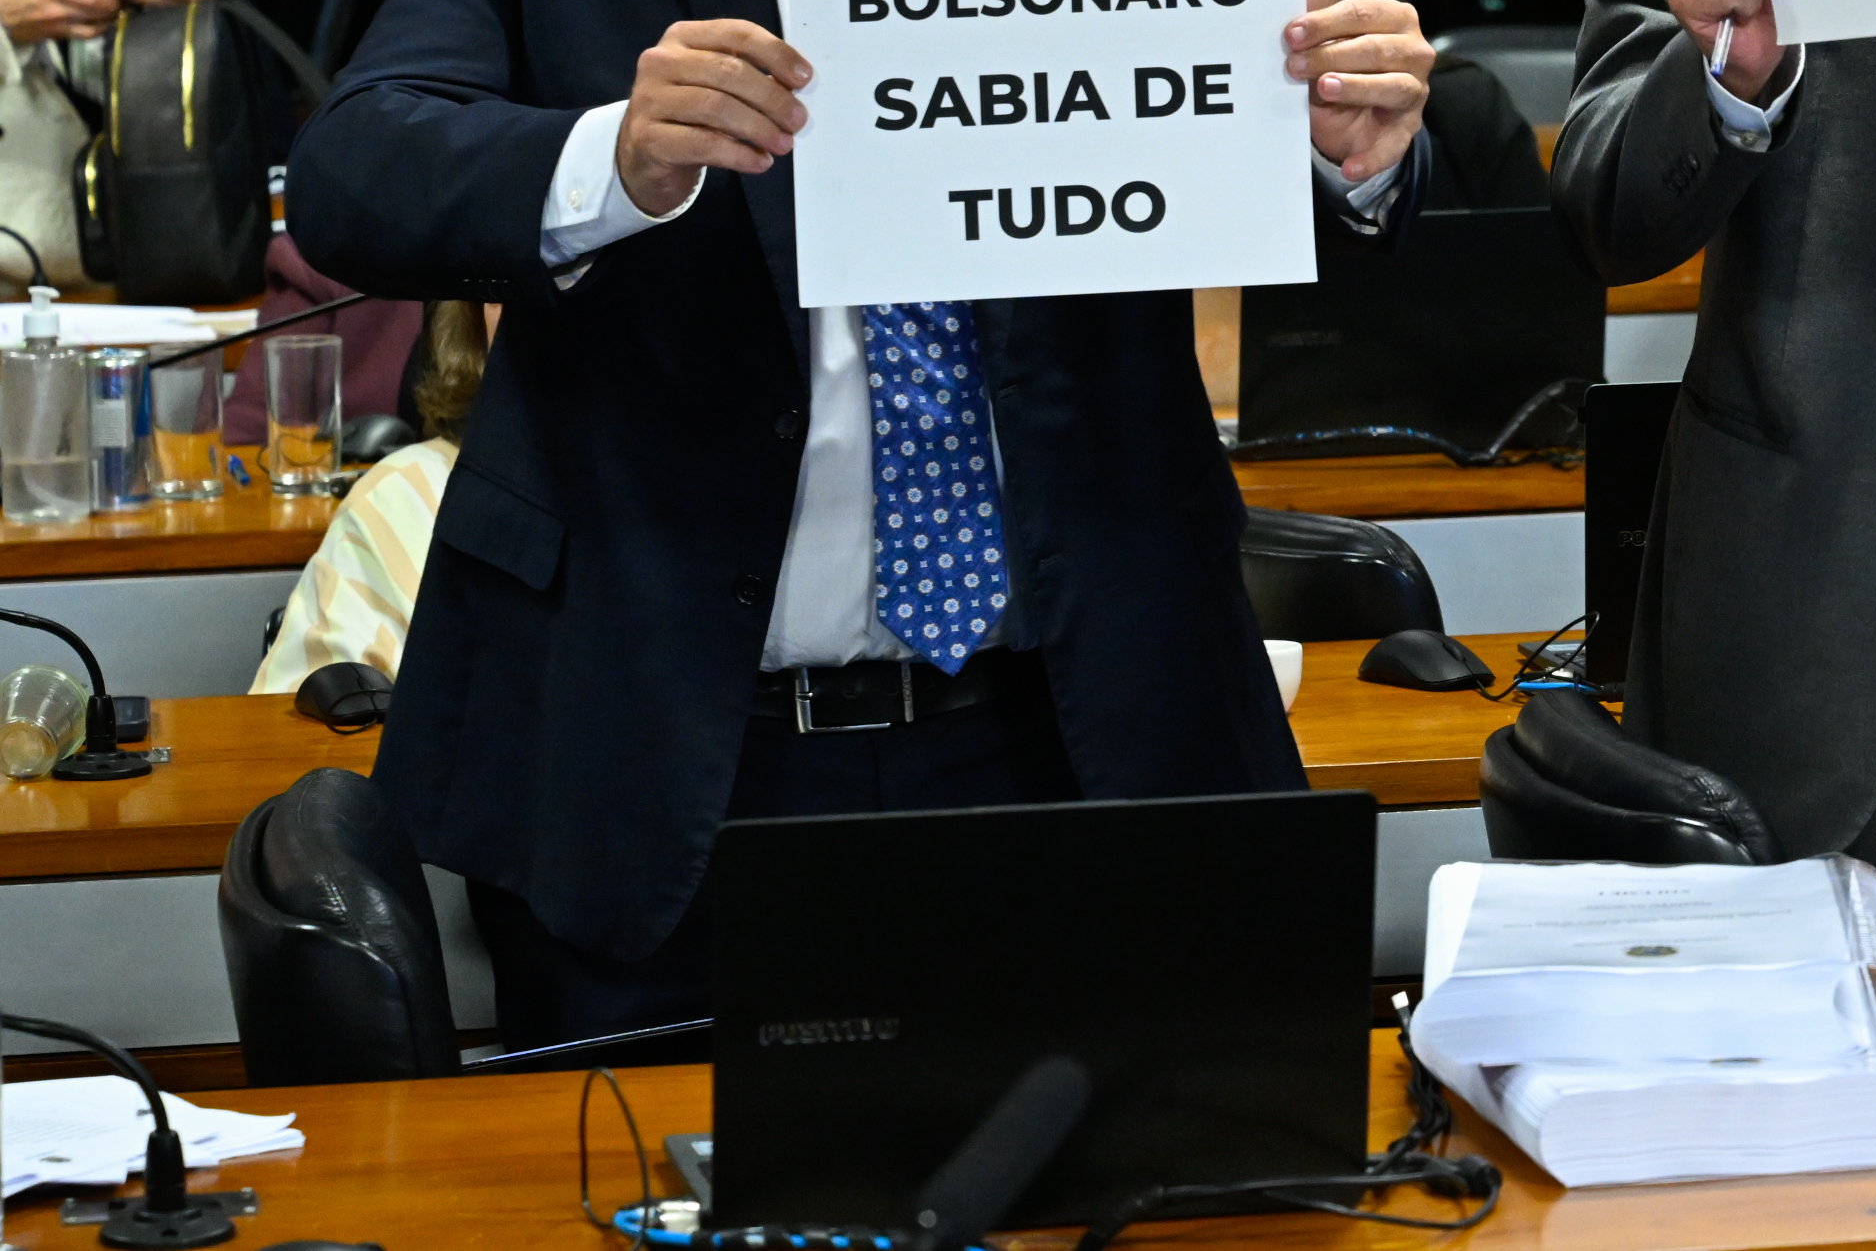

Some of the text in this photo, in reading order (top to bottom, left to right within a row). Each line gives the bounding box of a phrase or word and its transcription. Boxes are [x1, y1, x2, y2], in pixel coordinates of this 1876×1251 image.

[873, 62, 1235, 132] SABIA DE
[948, 180, 1167, 242] TUDO
